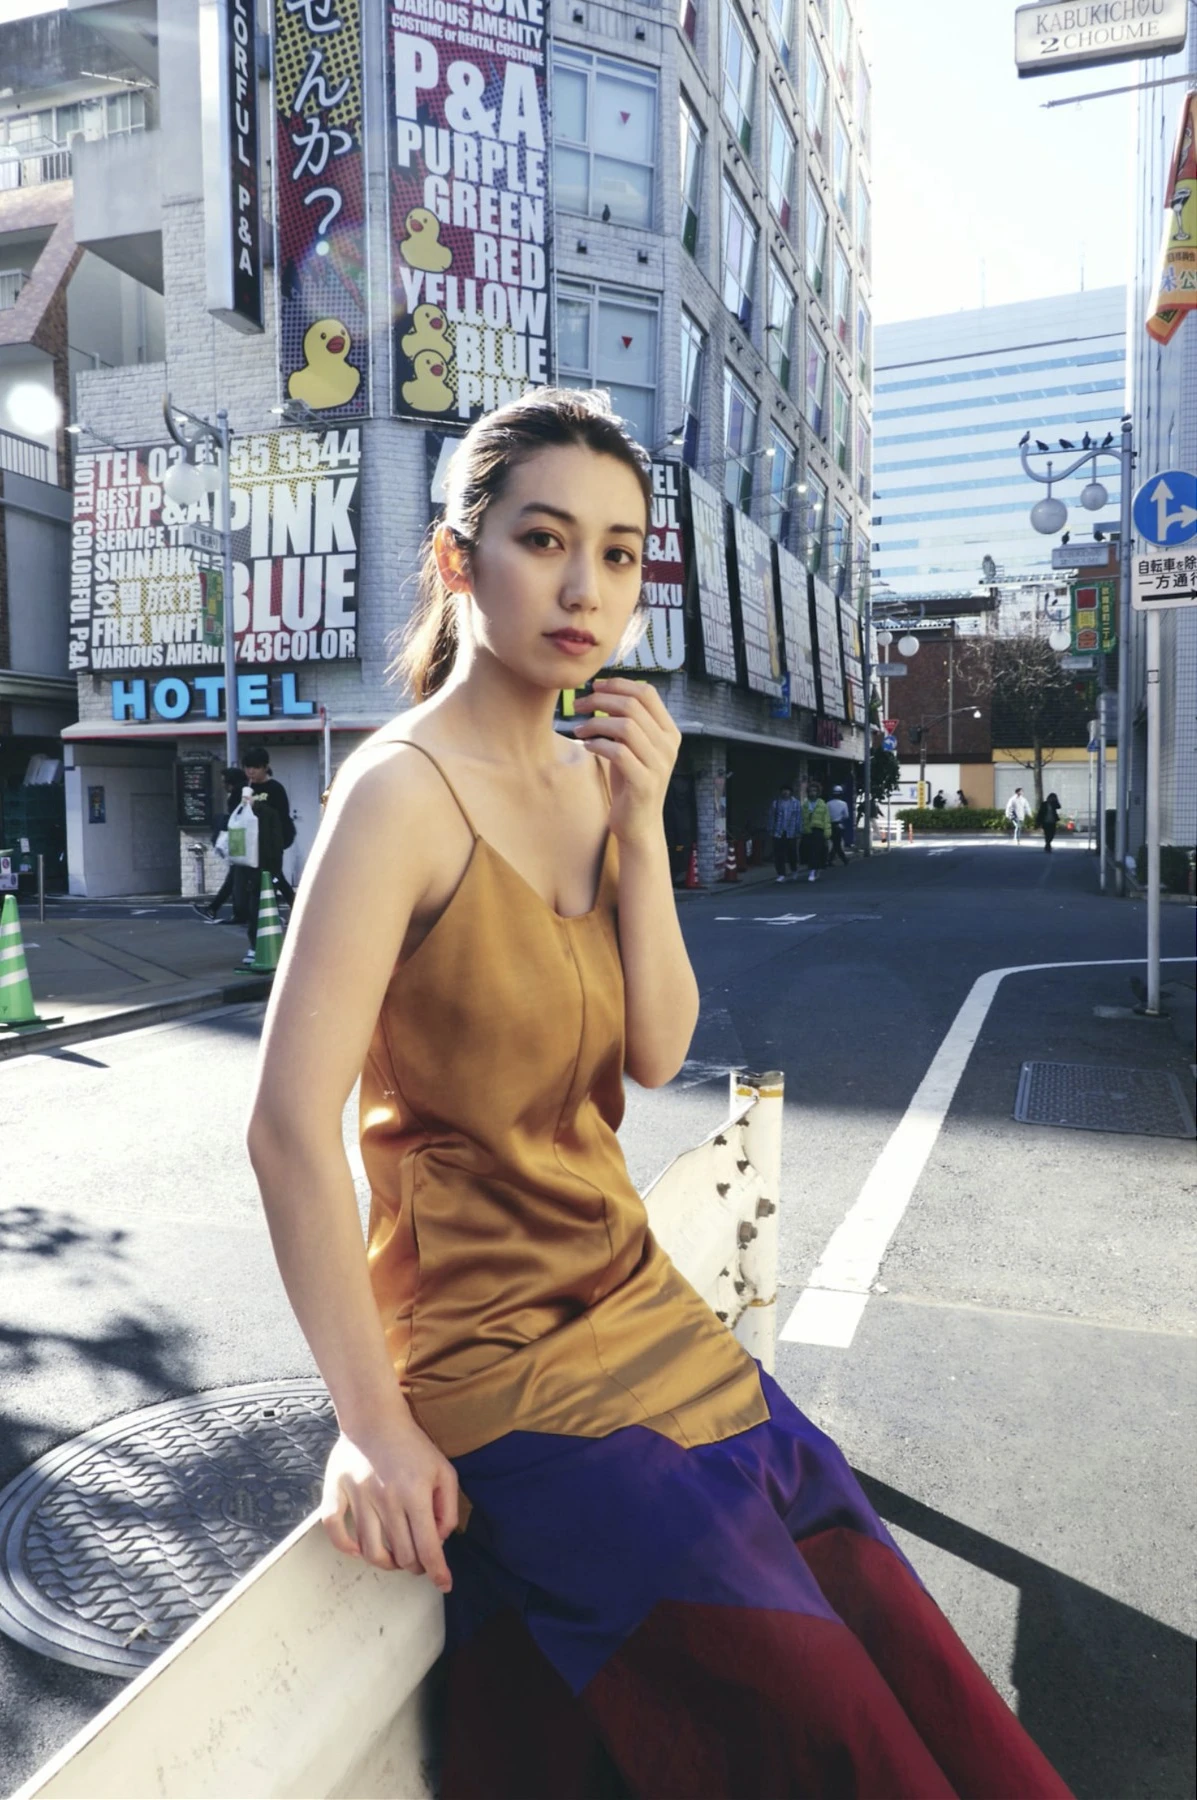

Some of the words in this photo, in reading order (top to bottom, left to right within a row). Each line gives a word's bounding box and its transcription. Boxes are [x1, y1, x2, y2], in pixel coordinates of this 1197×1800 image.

[391, 13, 443, 40] COSTUME
[458, 30, 495, 53] RENTAL
[496, 41, 544, 66] COSTUME
[393, 0, 469, 28] VARIOUS
[472, 10, 543, 49] AMENITY
[394, 30, 545, 151] P&A
[397, 118, 544, 195] PURPLE
[238, 185, 253, 277] P&A
[424, 174, 544, 243] GREEN
[474, 233, 545, 289] RED
[400, 267, 547, 336] YELLOW
[456, 325, 547, 383] BLUE
[458, 373, 534, 418] PIN
[73, 454, 95, 517] HOTEL
[95, 450, 141, 488] TEL
[278, 428, 361, 472] 5544
[95, 507, 138, 530] STAY
[96, 487, 139, 511] REST
[213, 477, 358, 557] PINK
[95, 526, 165, 551] SERVICE
[70, 520, 93, 624] COLORFUL
[231, 553, 357, 633] BLUE
[68, 627, 90, 670] P&A
[91, 645, 163, 669] VARIOUS
[92, 615, 146, 647] FREE
[240, 629, 356, 664] 43COLOR
[111, 672, 315, 721] HOTEL
